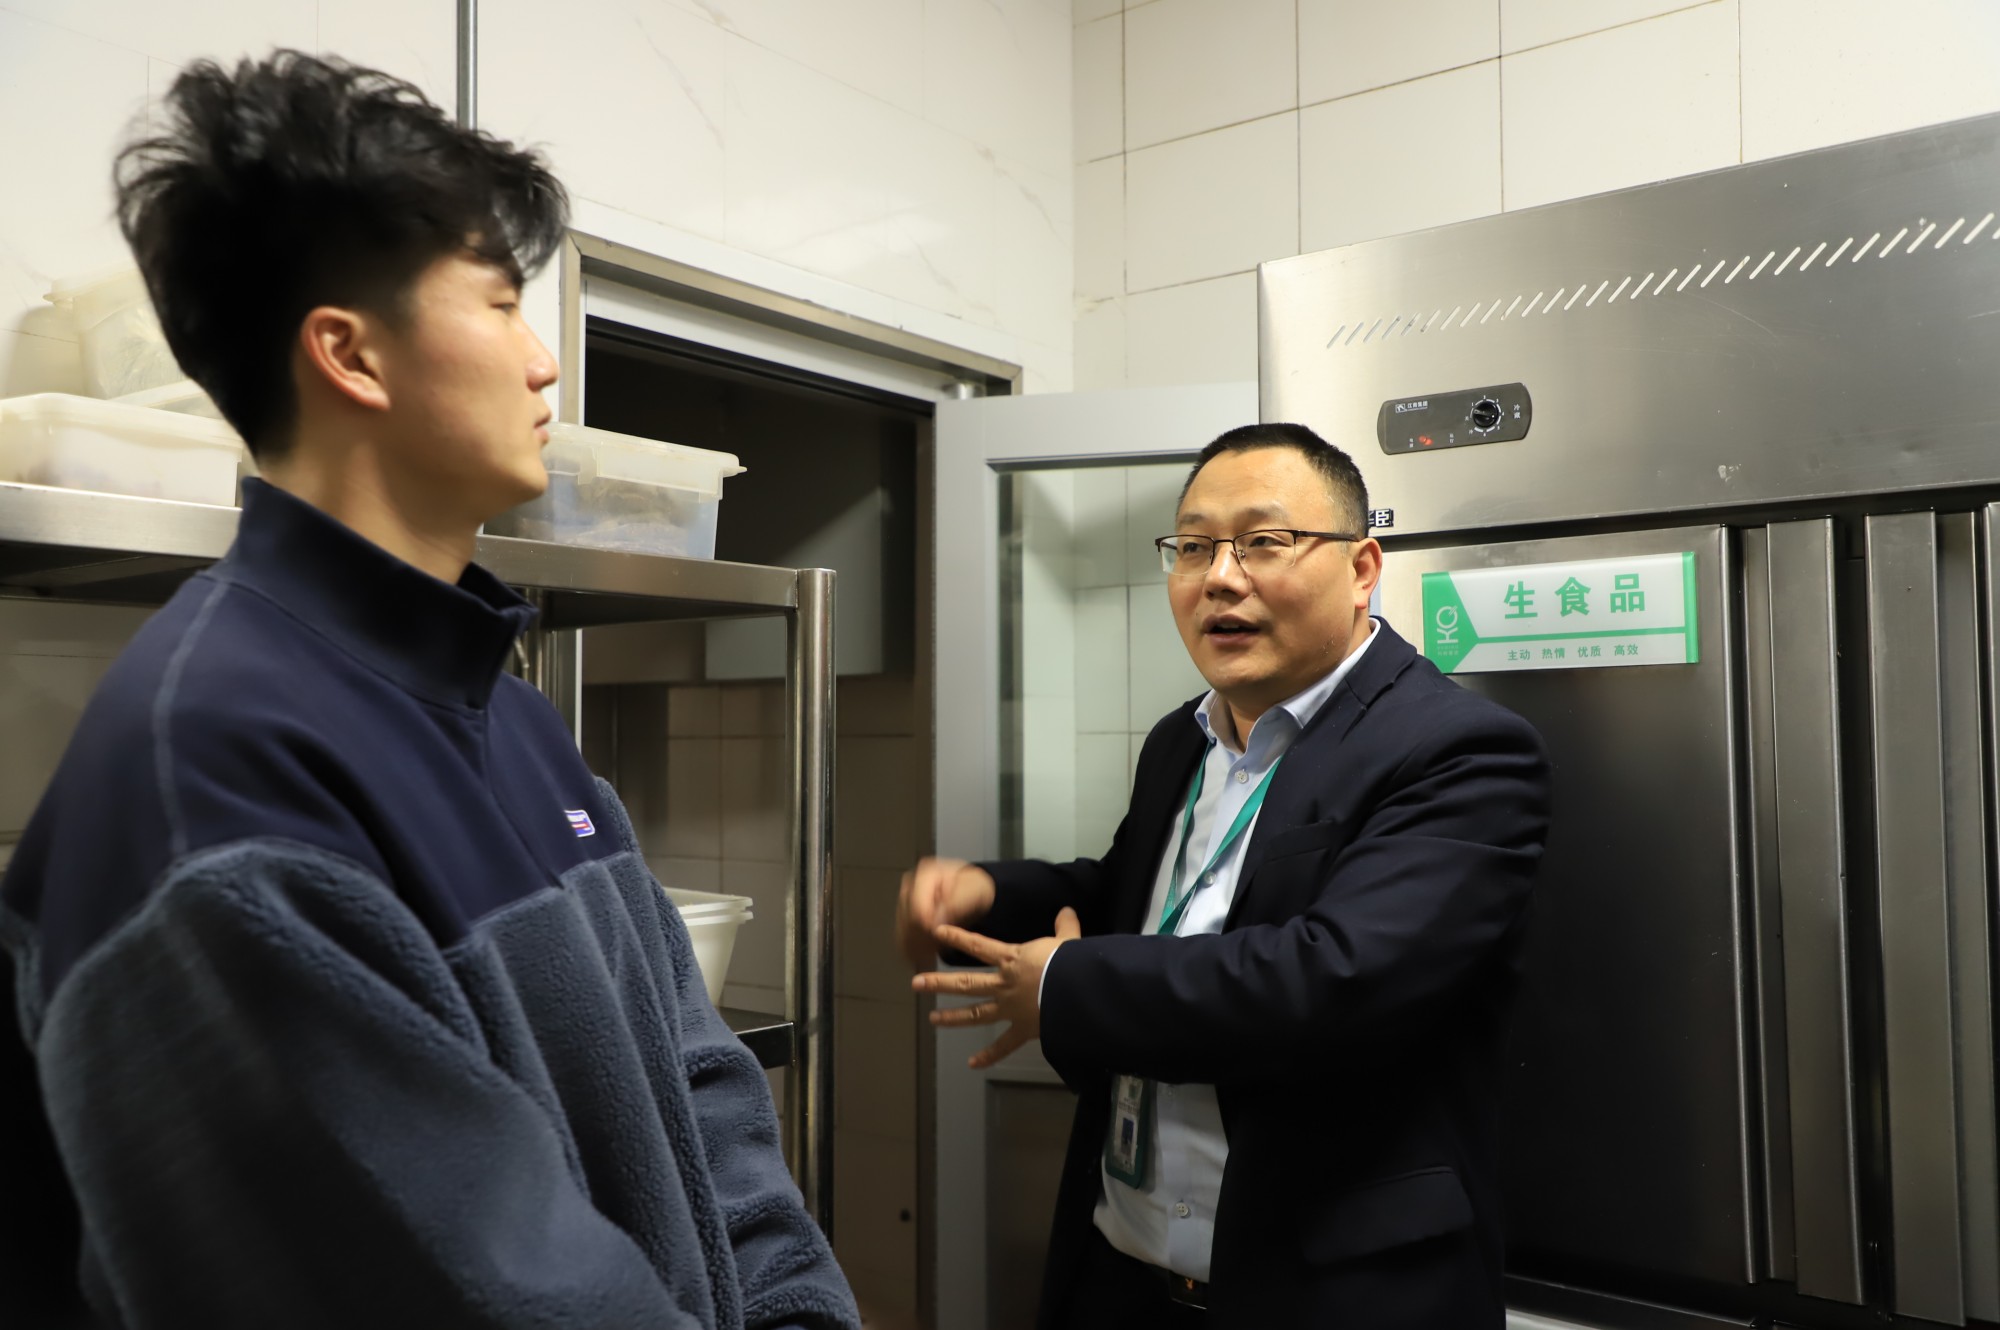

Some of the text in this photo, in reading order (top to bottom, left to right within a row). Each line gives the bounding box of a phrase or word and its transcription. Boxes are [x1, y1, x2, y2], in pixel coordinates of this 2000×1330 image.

[1503, 573, 1646, 620] 生食品
[1507, 643, 1639, 661] 主动 热情 优质 高效
